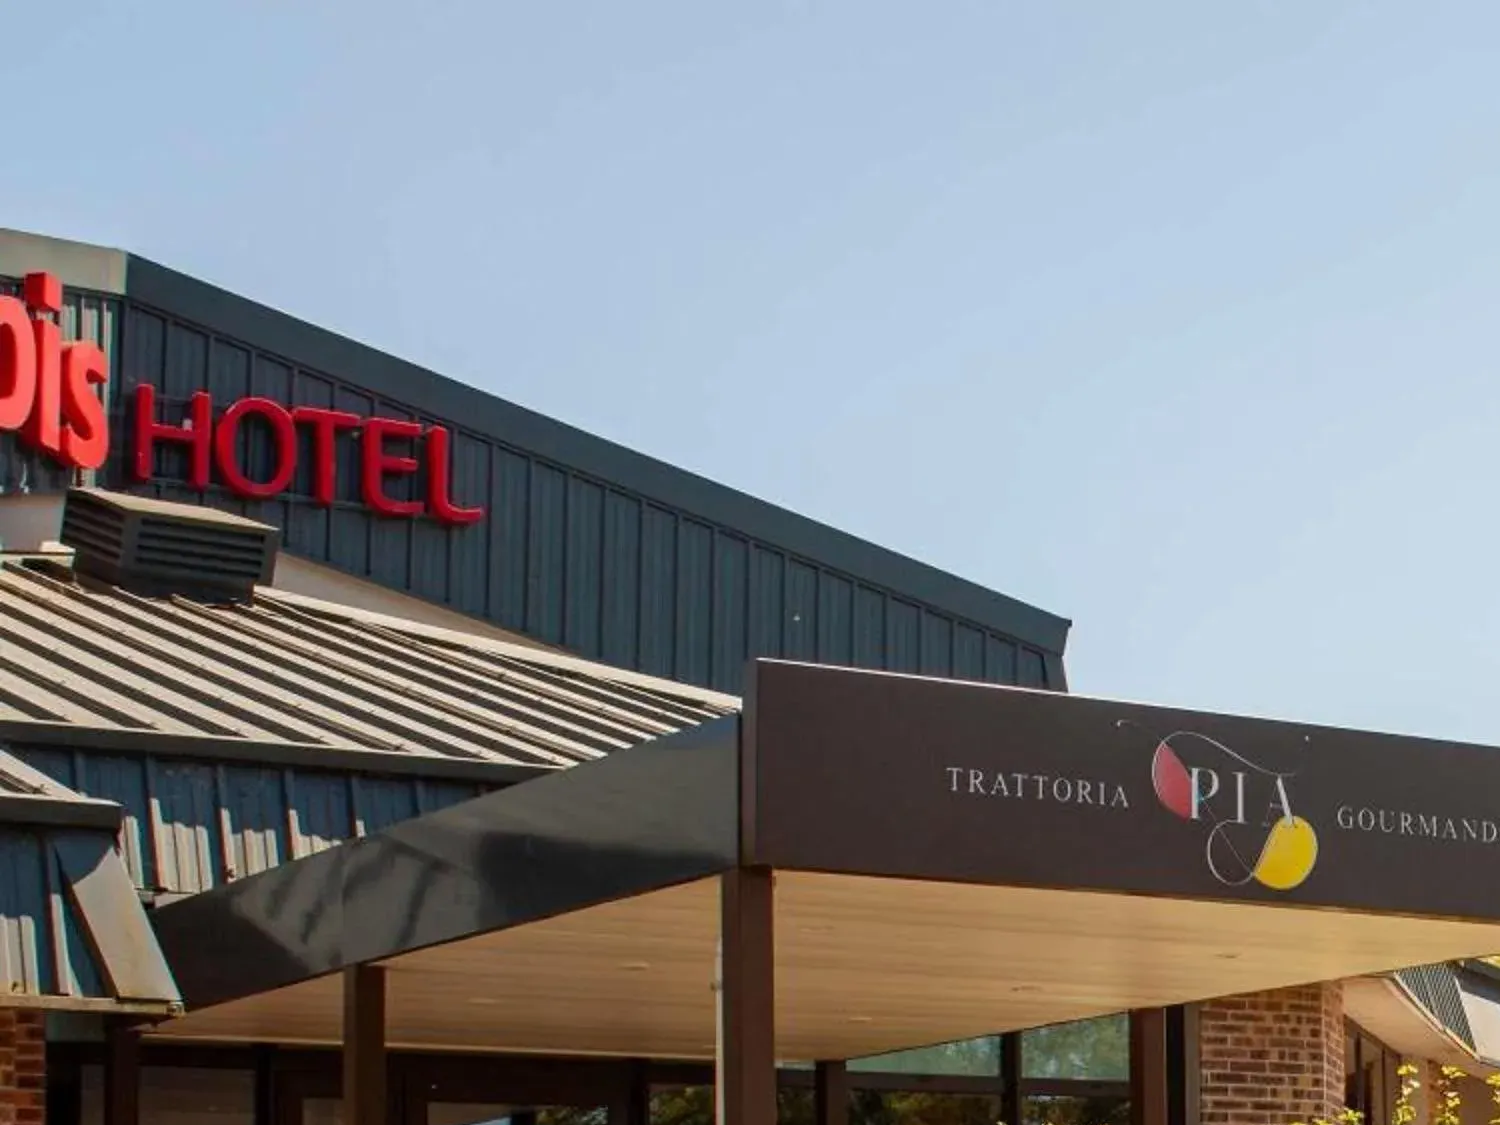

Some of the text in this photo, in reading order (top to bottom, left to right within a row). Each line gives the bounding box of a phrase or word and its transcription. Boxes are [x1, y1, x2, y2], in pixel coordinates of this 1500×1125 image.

[135, 383, 484, 525] HOTEL
[946, 766, 1130, 808] TRATTORIA
[1187, 766, 1298, 829] PIA
